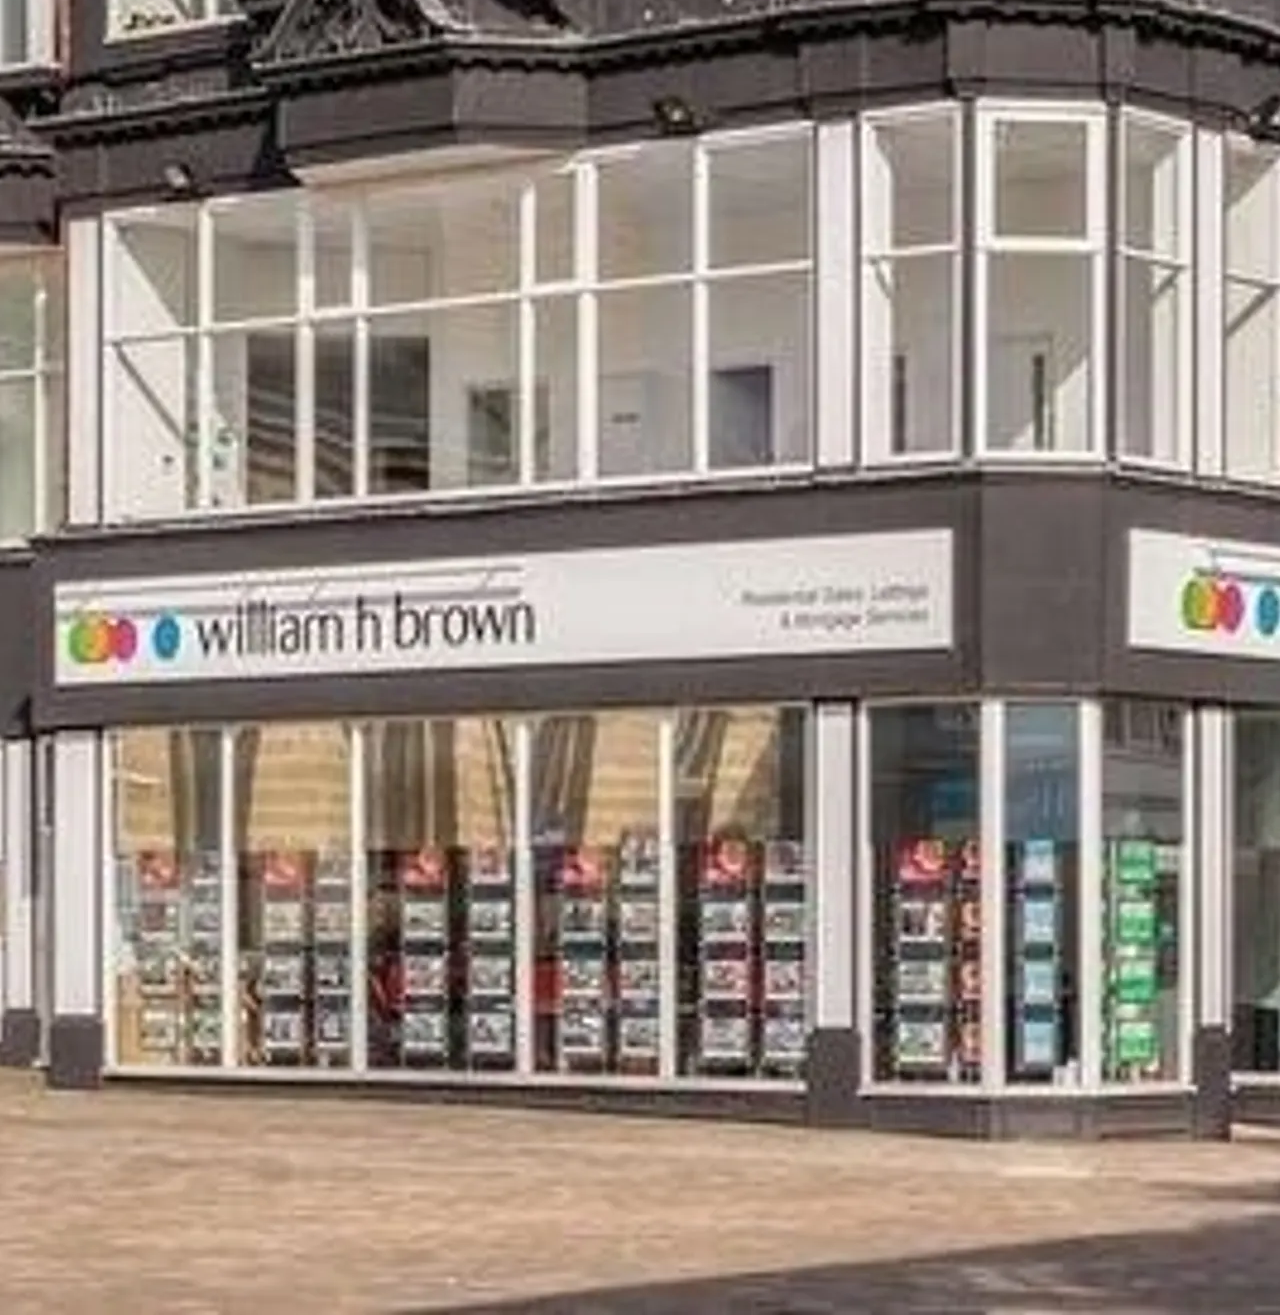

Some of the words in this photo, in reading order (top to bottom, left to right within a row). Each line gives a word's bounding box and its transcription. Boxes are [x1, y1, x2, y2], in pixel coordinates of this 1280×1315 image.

[196, 599, 345, 658] william
[355, 594, 382, 655] h
[391, 590, 536, 648] brown
